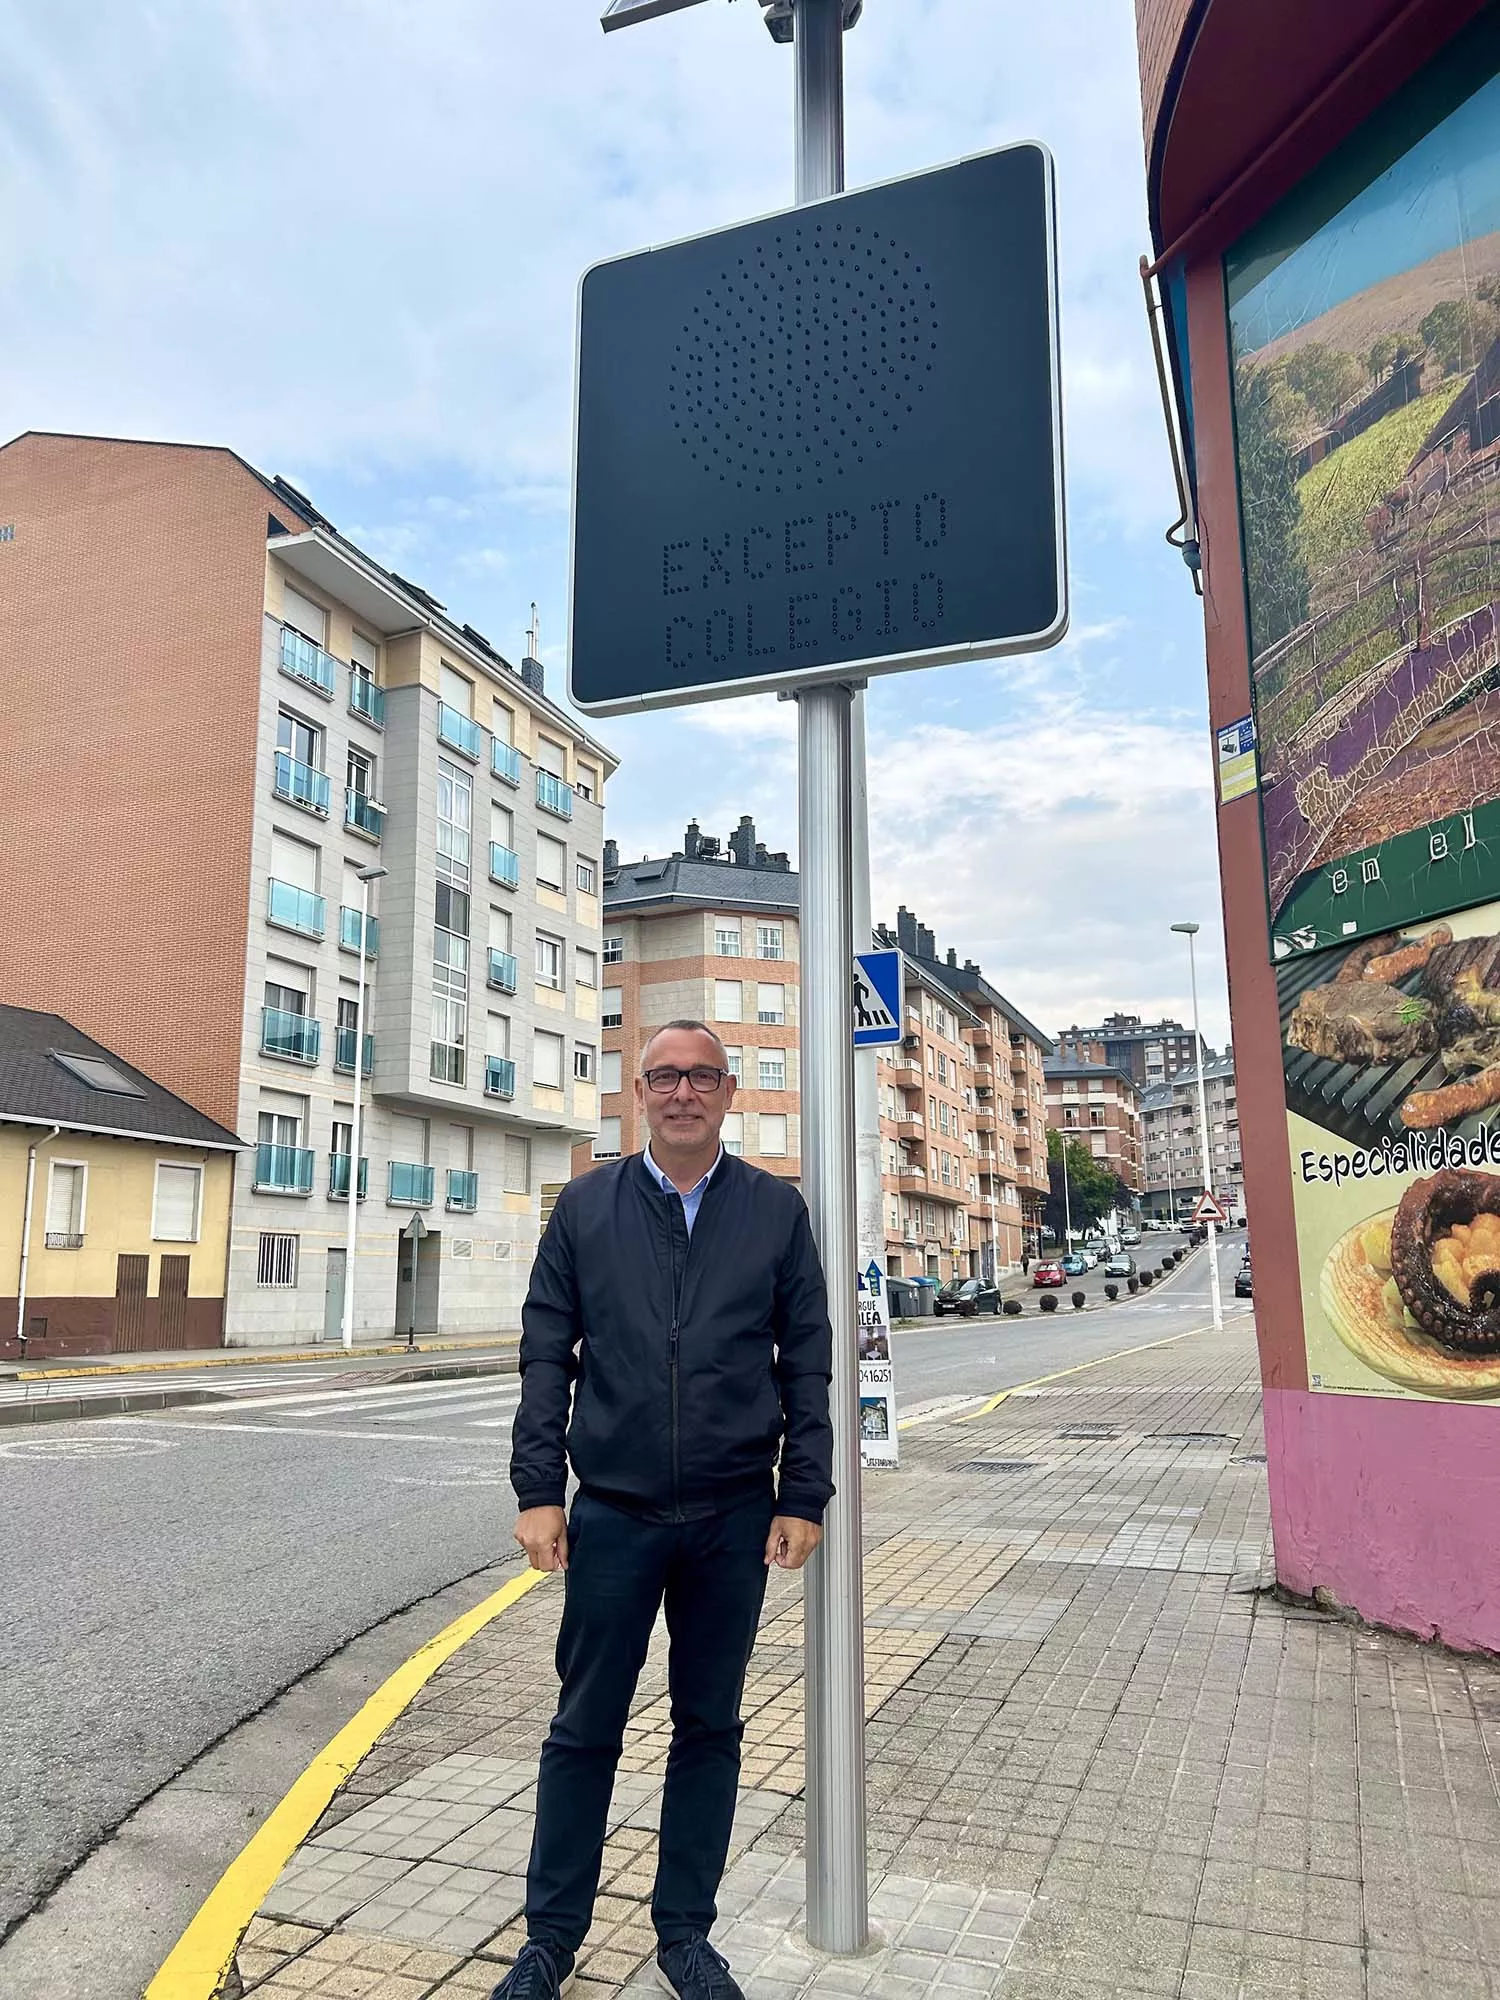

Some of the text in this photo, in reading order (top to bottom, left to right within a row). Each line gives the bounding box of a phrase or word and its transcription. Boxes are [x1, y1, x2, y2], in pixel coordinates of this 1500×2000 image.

[663, 491, 947, 597] EXCEPTO
[665, 570, 945, 669] COLEGIO
[1332, 857, 1381, 895] en
